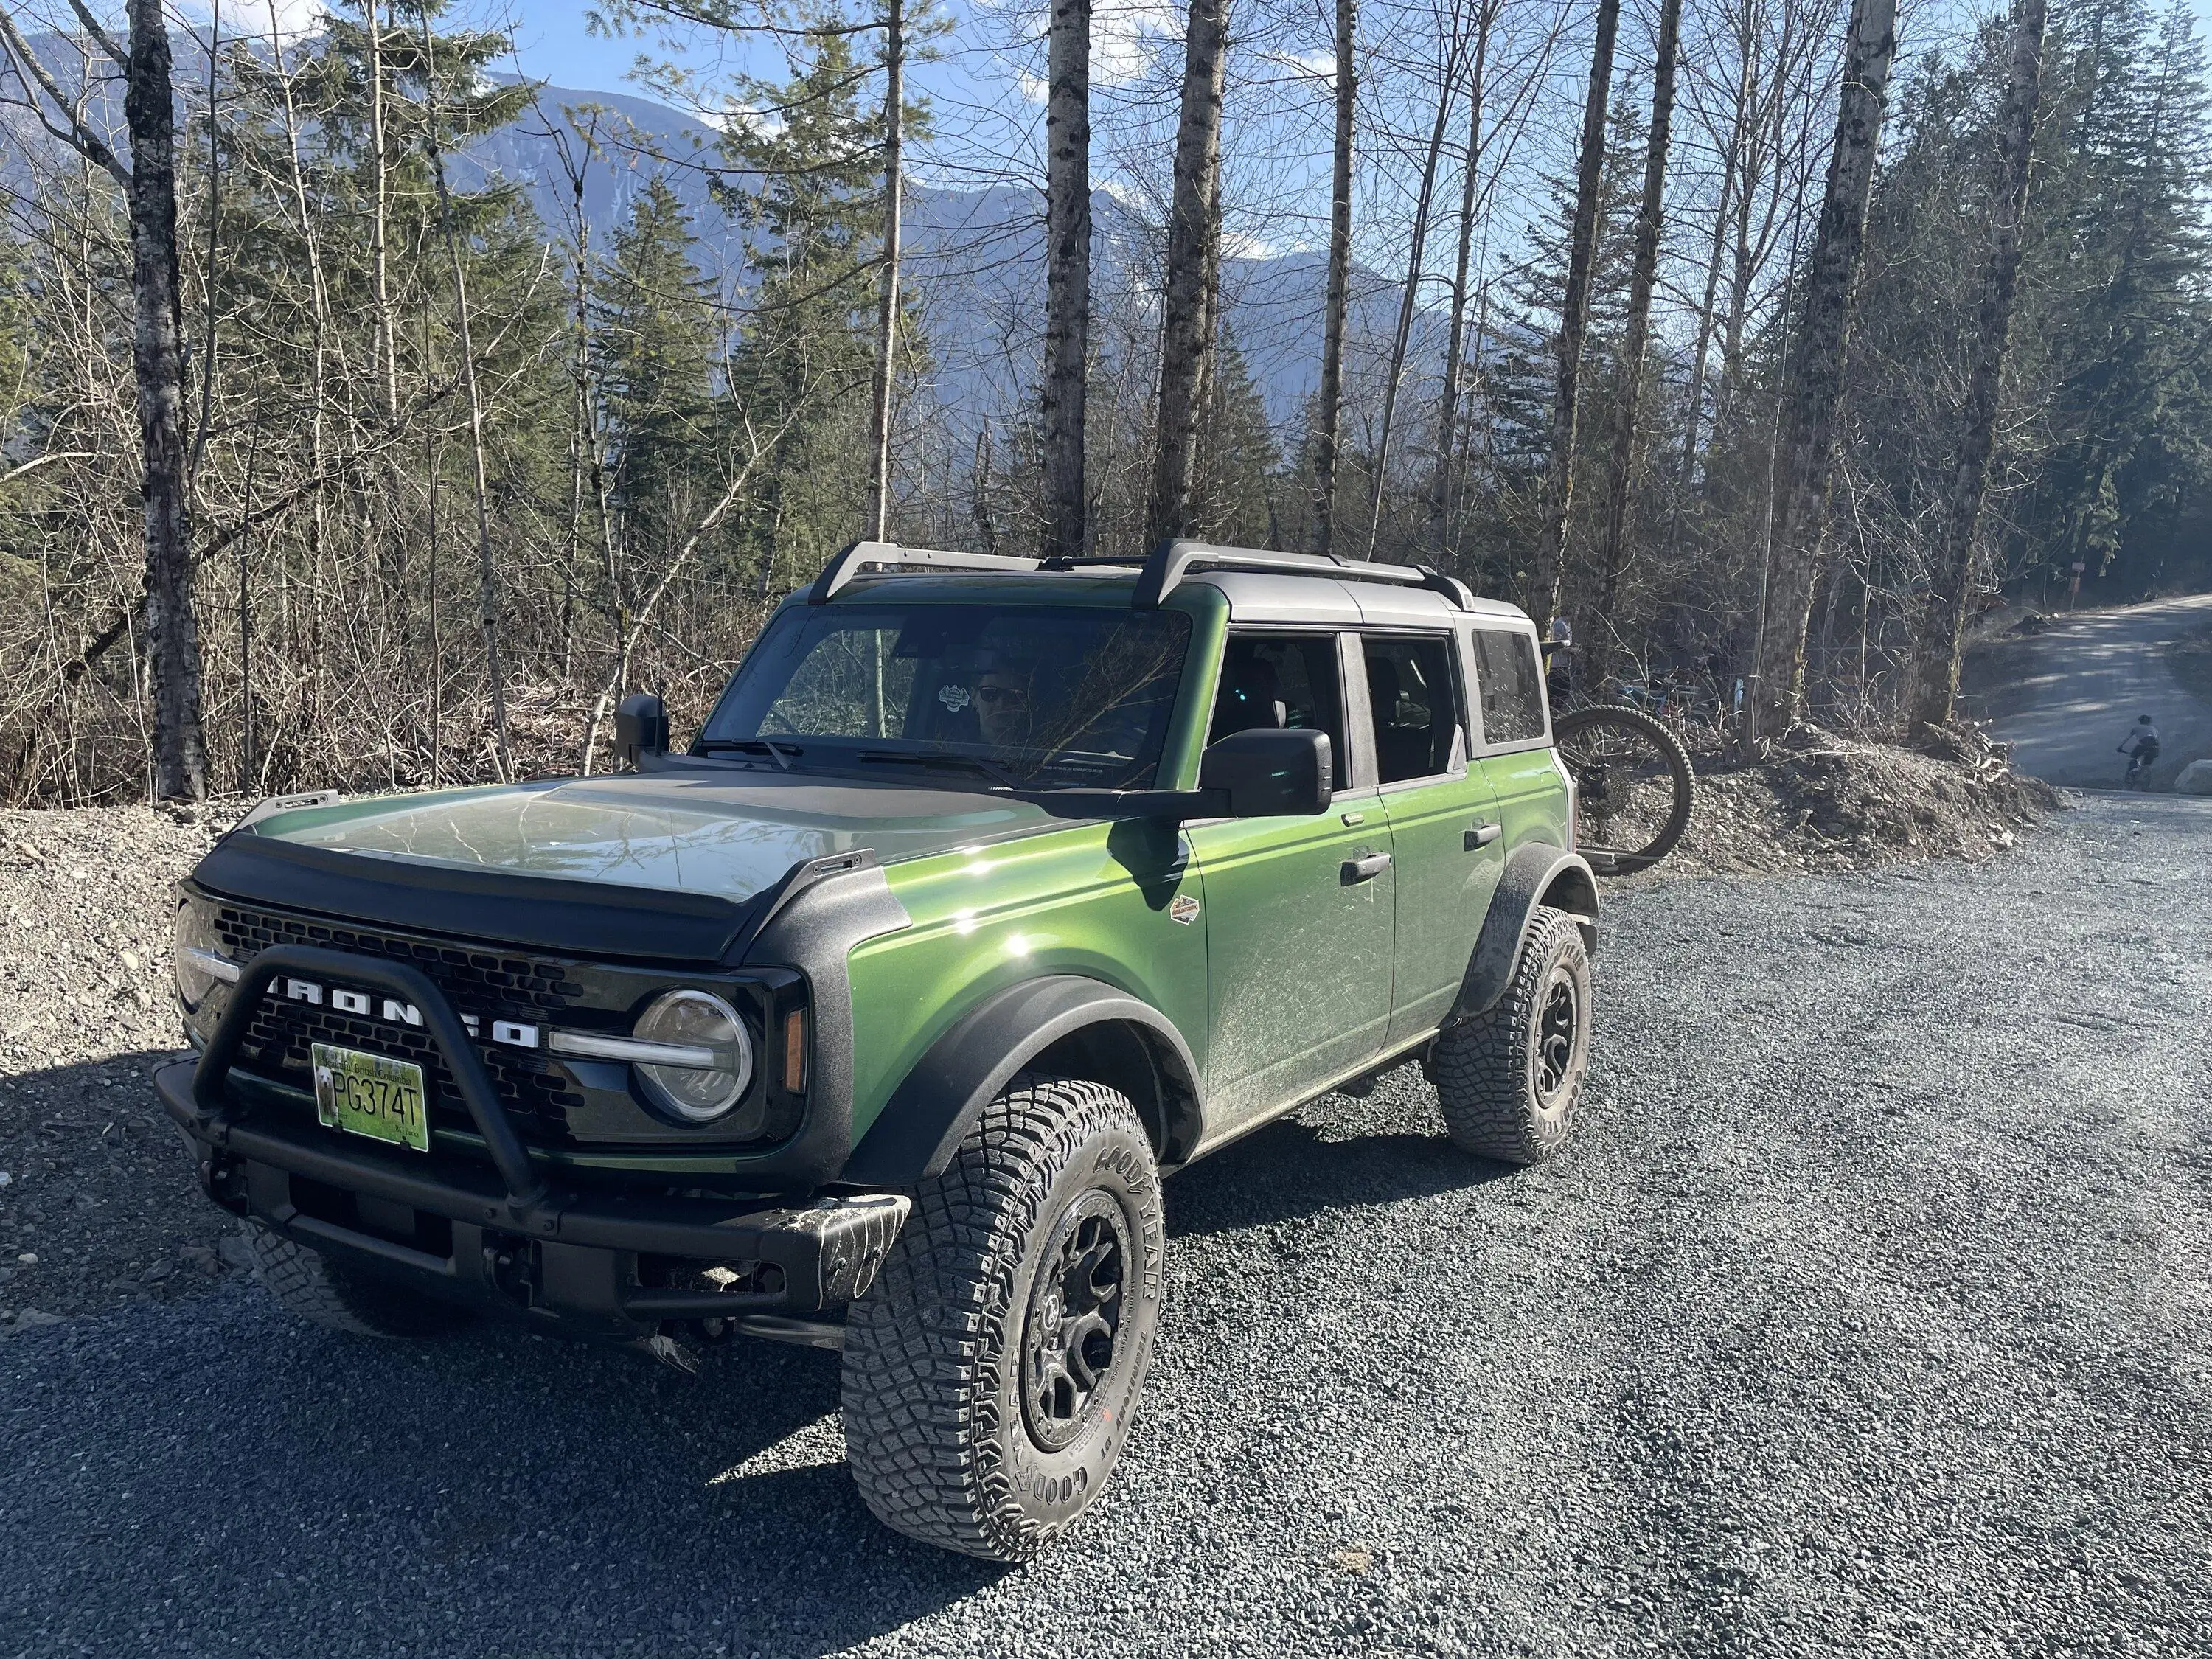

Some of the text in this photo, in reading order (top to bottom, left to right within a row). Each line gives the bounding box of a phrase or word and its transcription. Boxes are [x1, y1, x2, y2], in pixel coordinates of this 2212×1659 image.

[266, 975, 539, 1048] RONO
[332, 1071, 417, 1126] PG374T
[355, 1063, 377, 1077] British
[378, 1069, 412, 1086] Columbia
[1115, 1330, 1149, 1431] TERRITORY
